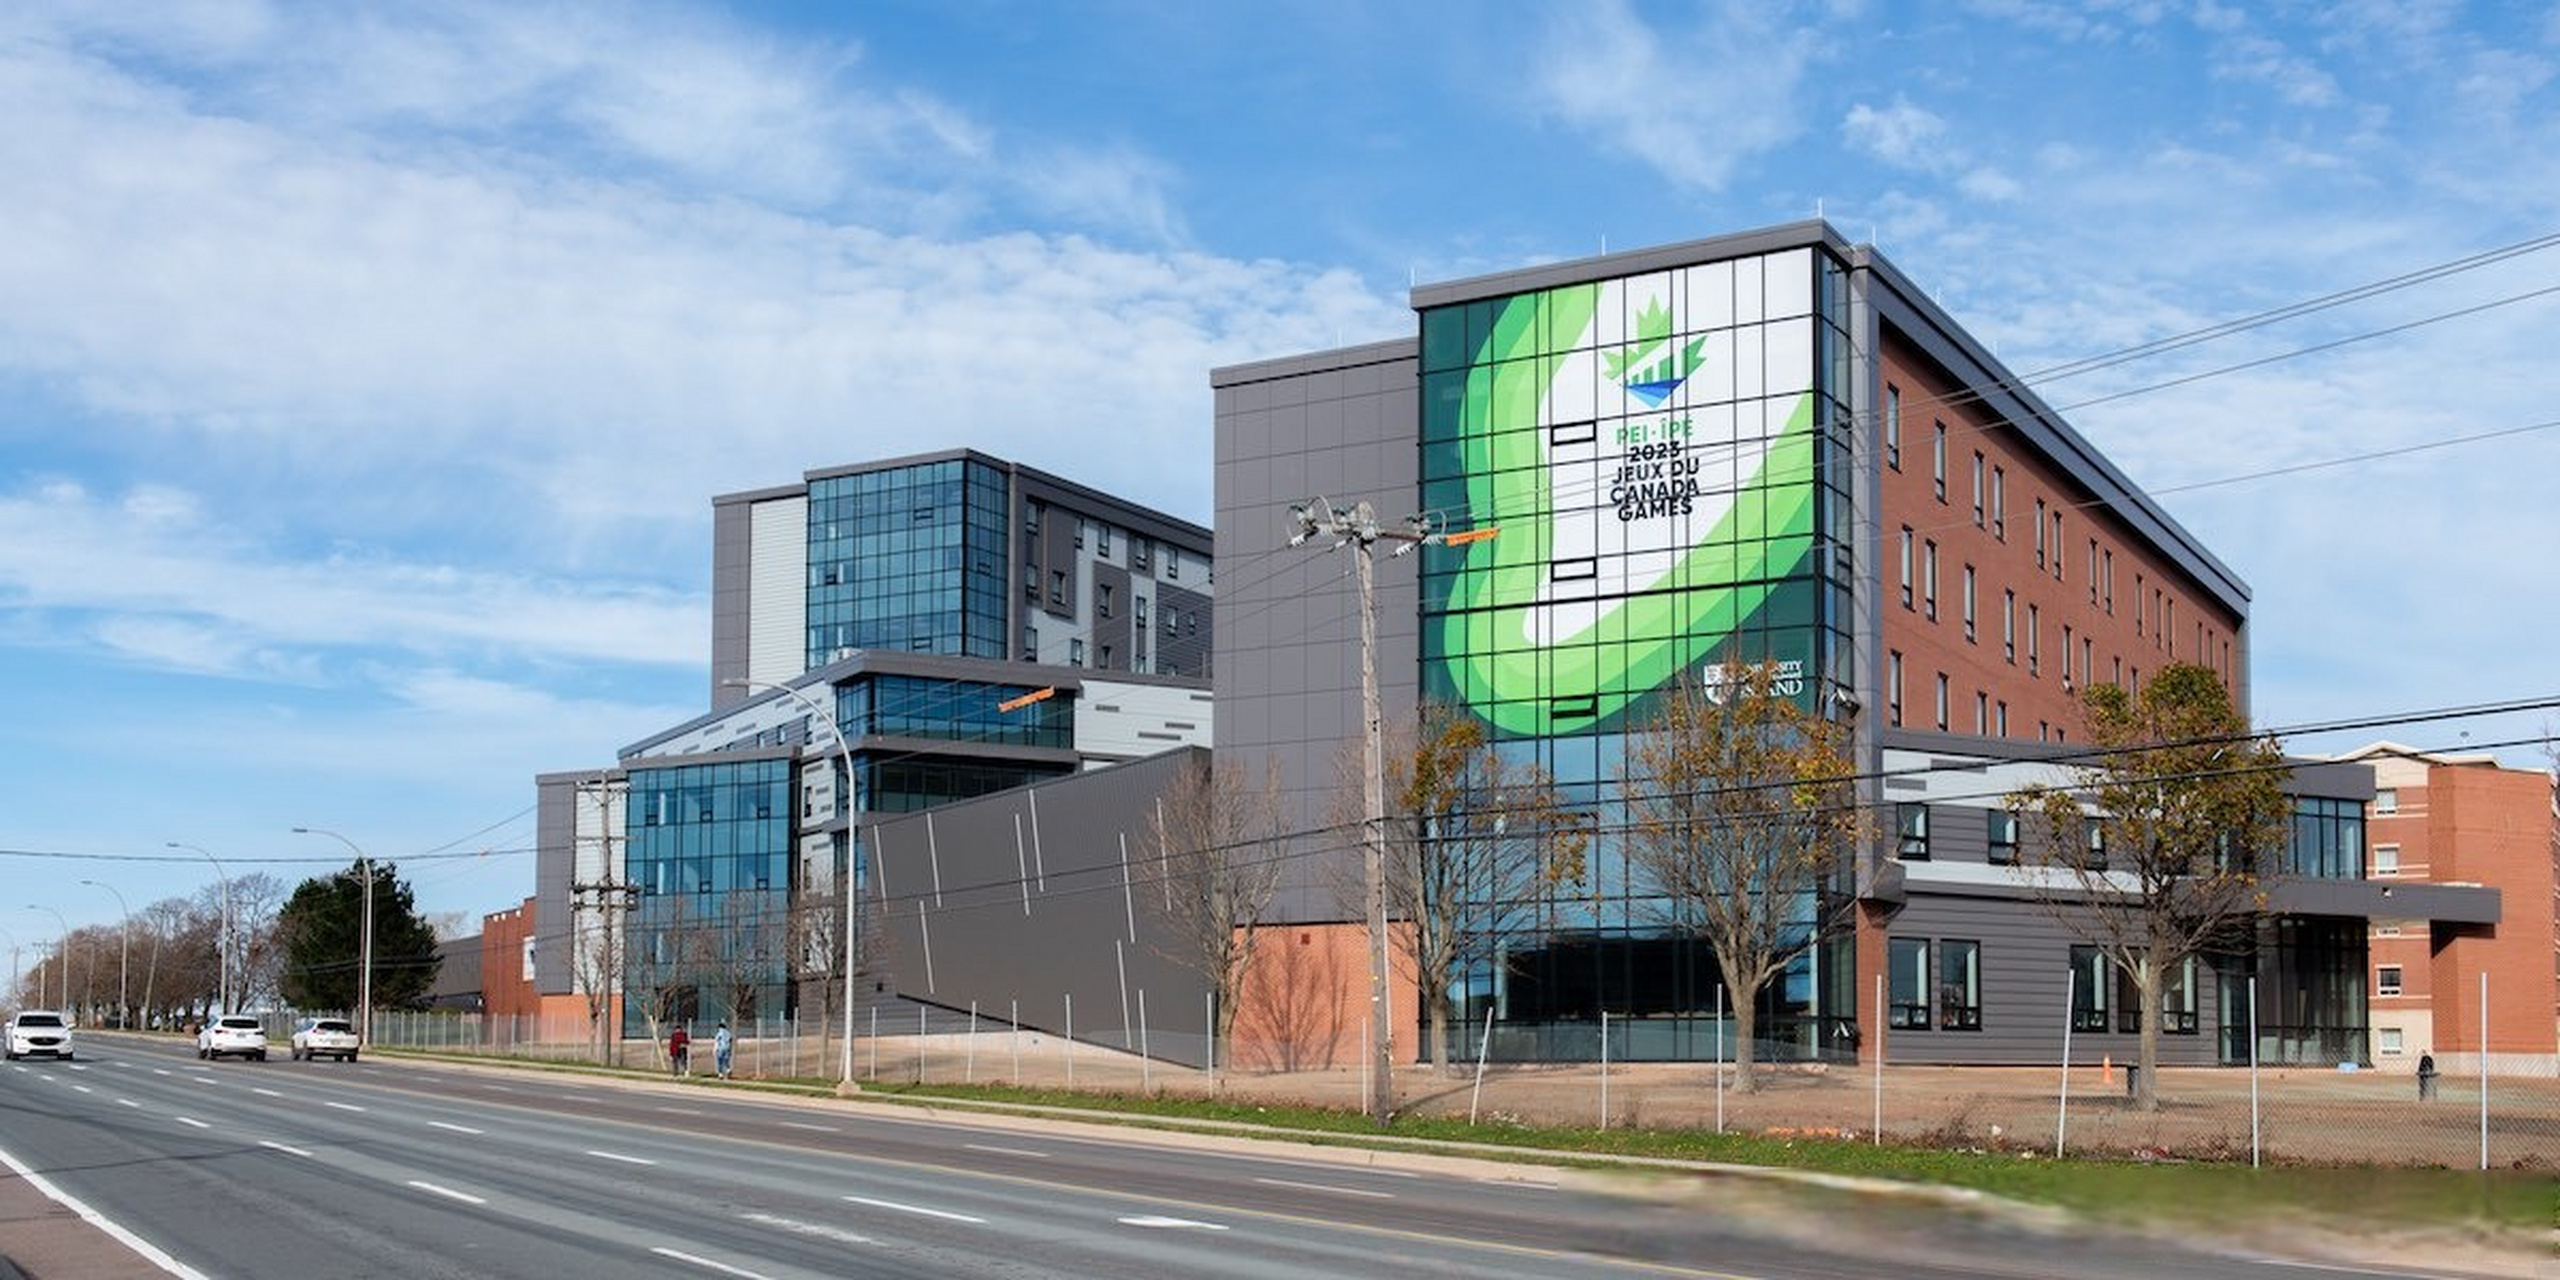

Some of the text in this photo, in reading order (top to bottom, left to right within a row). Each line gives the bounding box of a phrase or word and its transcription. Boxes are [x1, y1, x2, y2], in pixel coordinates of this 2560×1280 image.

[1630, 440, 1680, 462] 2023
[1612, 457, 1699, 484] JEUX DU
[1610, 478, 1700, 505] CANADA
[1618, 495, 1693, 522] GAMES
